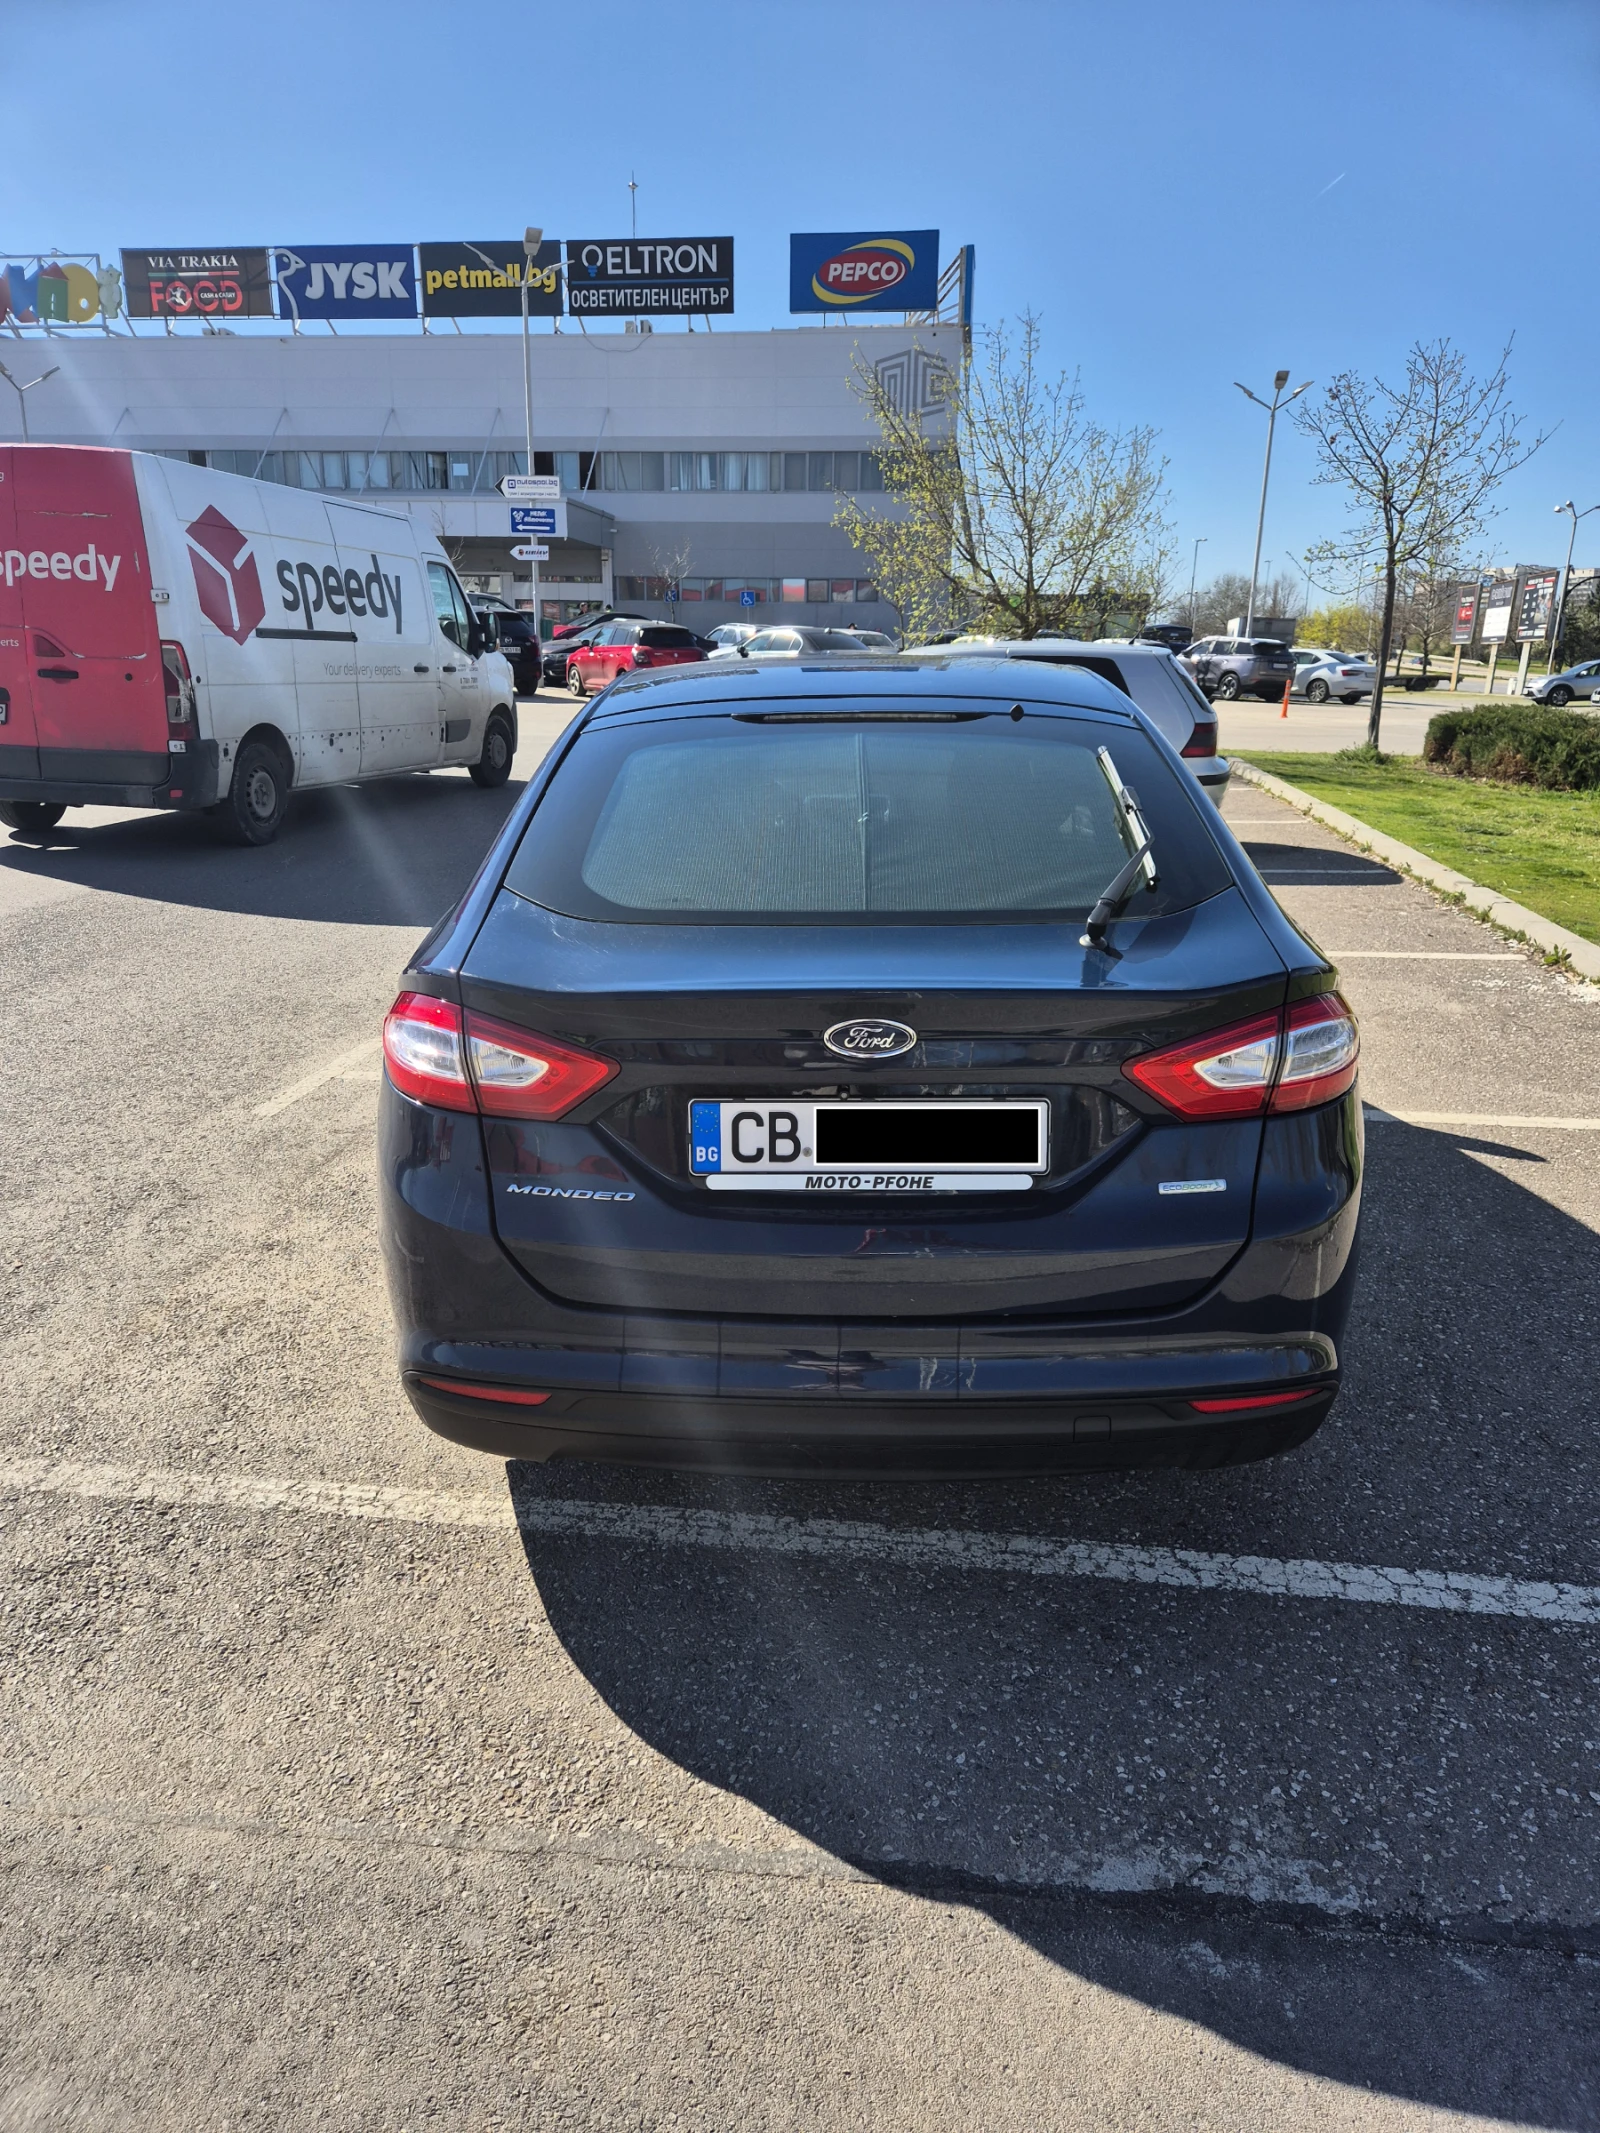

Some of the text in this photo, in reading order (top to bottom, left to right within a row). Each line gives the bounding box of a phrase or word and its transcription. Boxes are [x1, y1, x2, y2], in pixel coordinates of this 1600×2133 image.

[147, 254, 239, 268] VIA TRAKIA
[606, 244, 718, 275] ELTRON
[305, 261, 410, 299] JYSK
[426, 263, 557, 294] petmallbg
[828, 261, 899, 282] PEPCO
[571, 287, 730, 309] ОСВЕТИТЕЛЕН ЦЕНТЪР
[0, 543, 121, 591] peedy
[276, 553, 403, 635] speedy
[323, 662, 402, 679] Your delivery experts
[844, 1026, 896, 1048] Ford
[696, 1146, 718, 1162] BG
[506, 1183, 636, 1202] MONDEO
[1163, 1183, 1213, 1192] ECOBOOST
